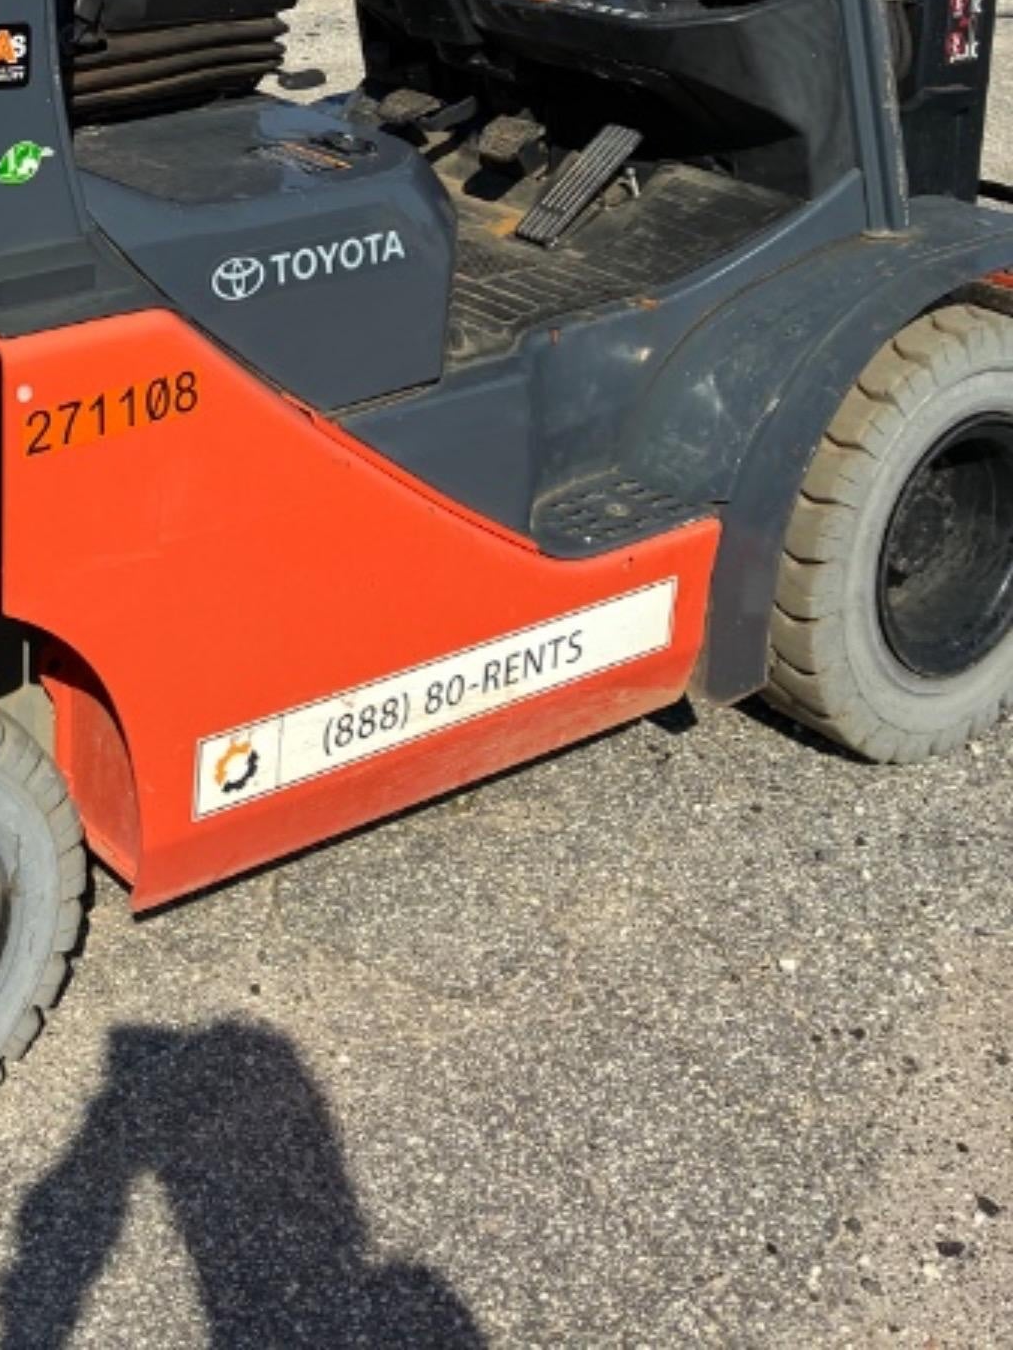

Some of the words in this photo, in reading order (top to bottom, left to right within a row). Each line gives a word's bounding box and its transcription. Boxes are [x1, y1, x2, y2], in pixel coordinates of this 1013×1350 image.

[269, 229, 406, 286] TOYOTA
[25, 370, 199, 457] 271108
[322, 692, 411, 757] (888)
[423, 629, 585, 717] 80-RENTS
